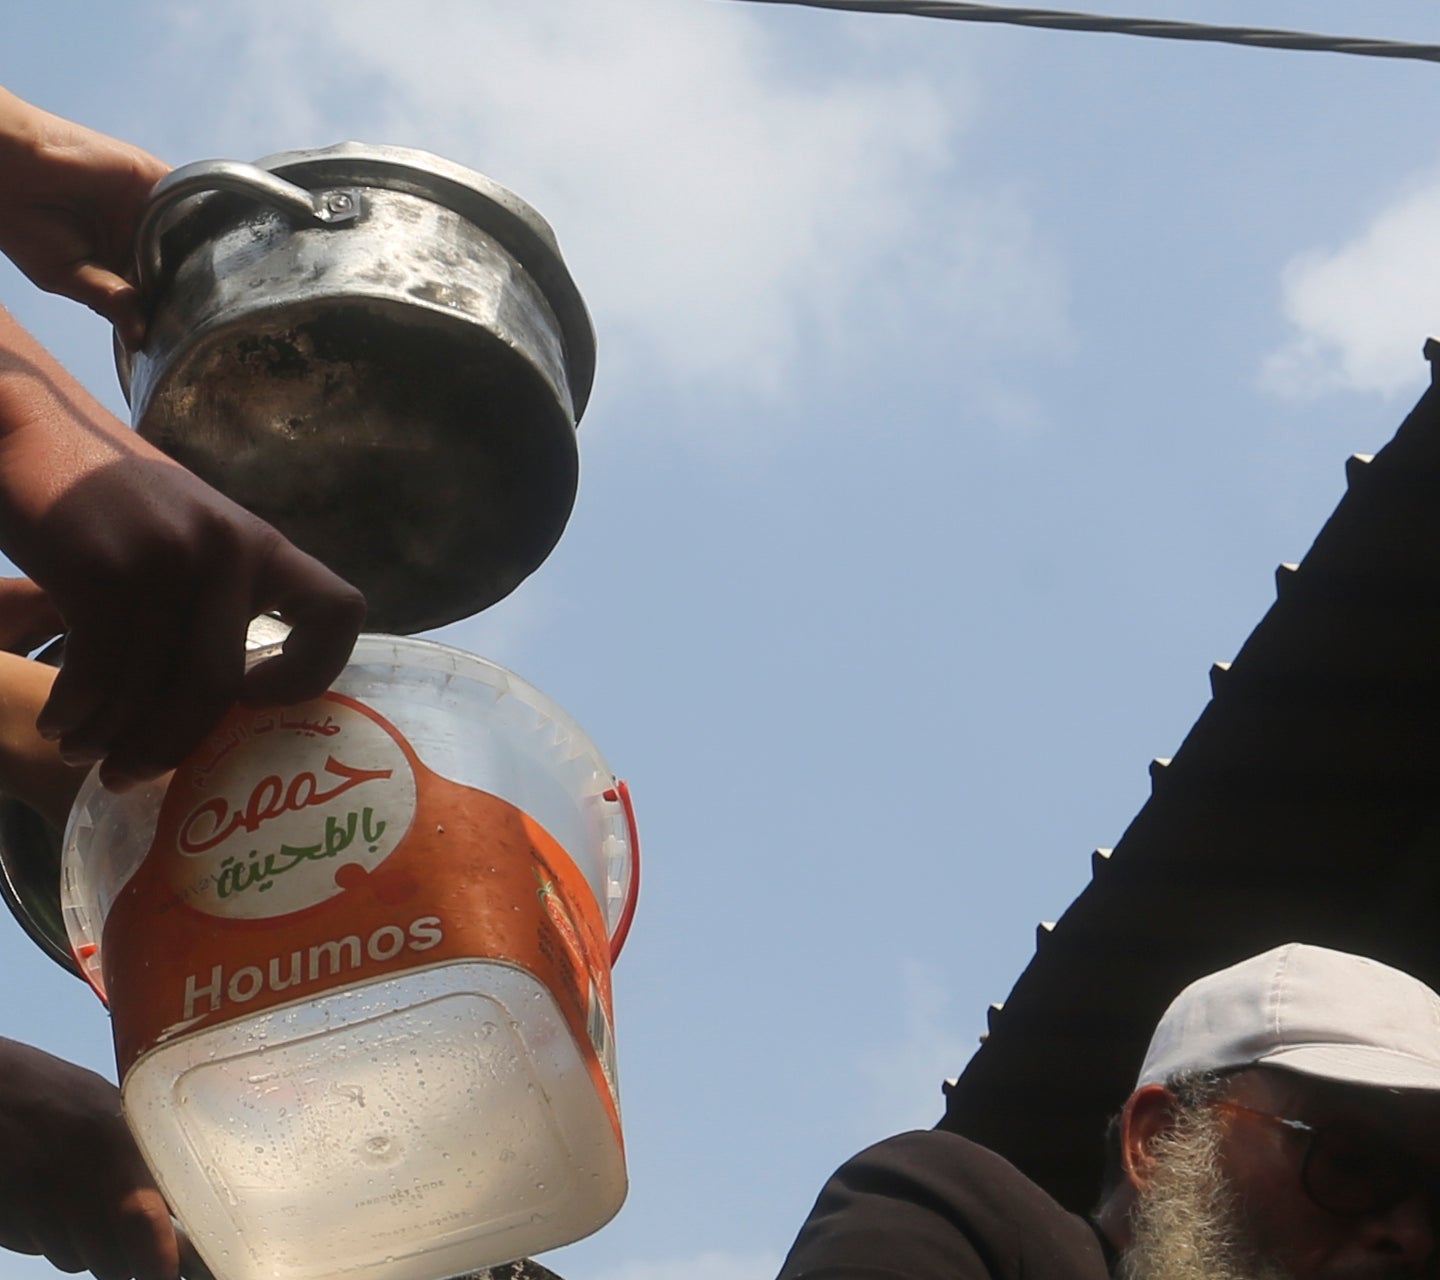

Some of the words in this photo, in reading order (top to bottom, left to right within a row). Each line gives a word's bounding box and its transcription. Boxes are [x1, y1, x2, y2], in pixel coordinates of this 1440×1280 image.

[178, 754, 394, 854] حمص
[216, 806, 387, 899] بالطحينة
[181, 914, 445, 1020] Houmos
